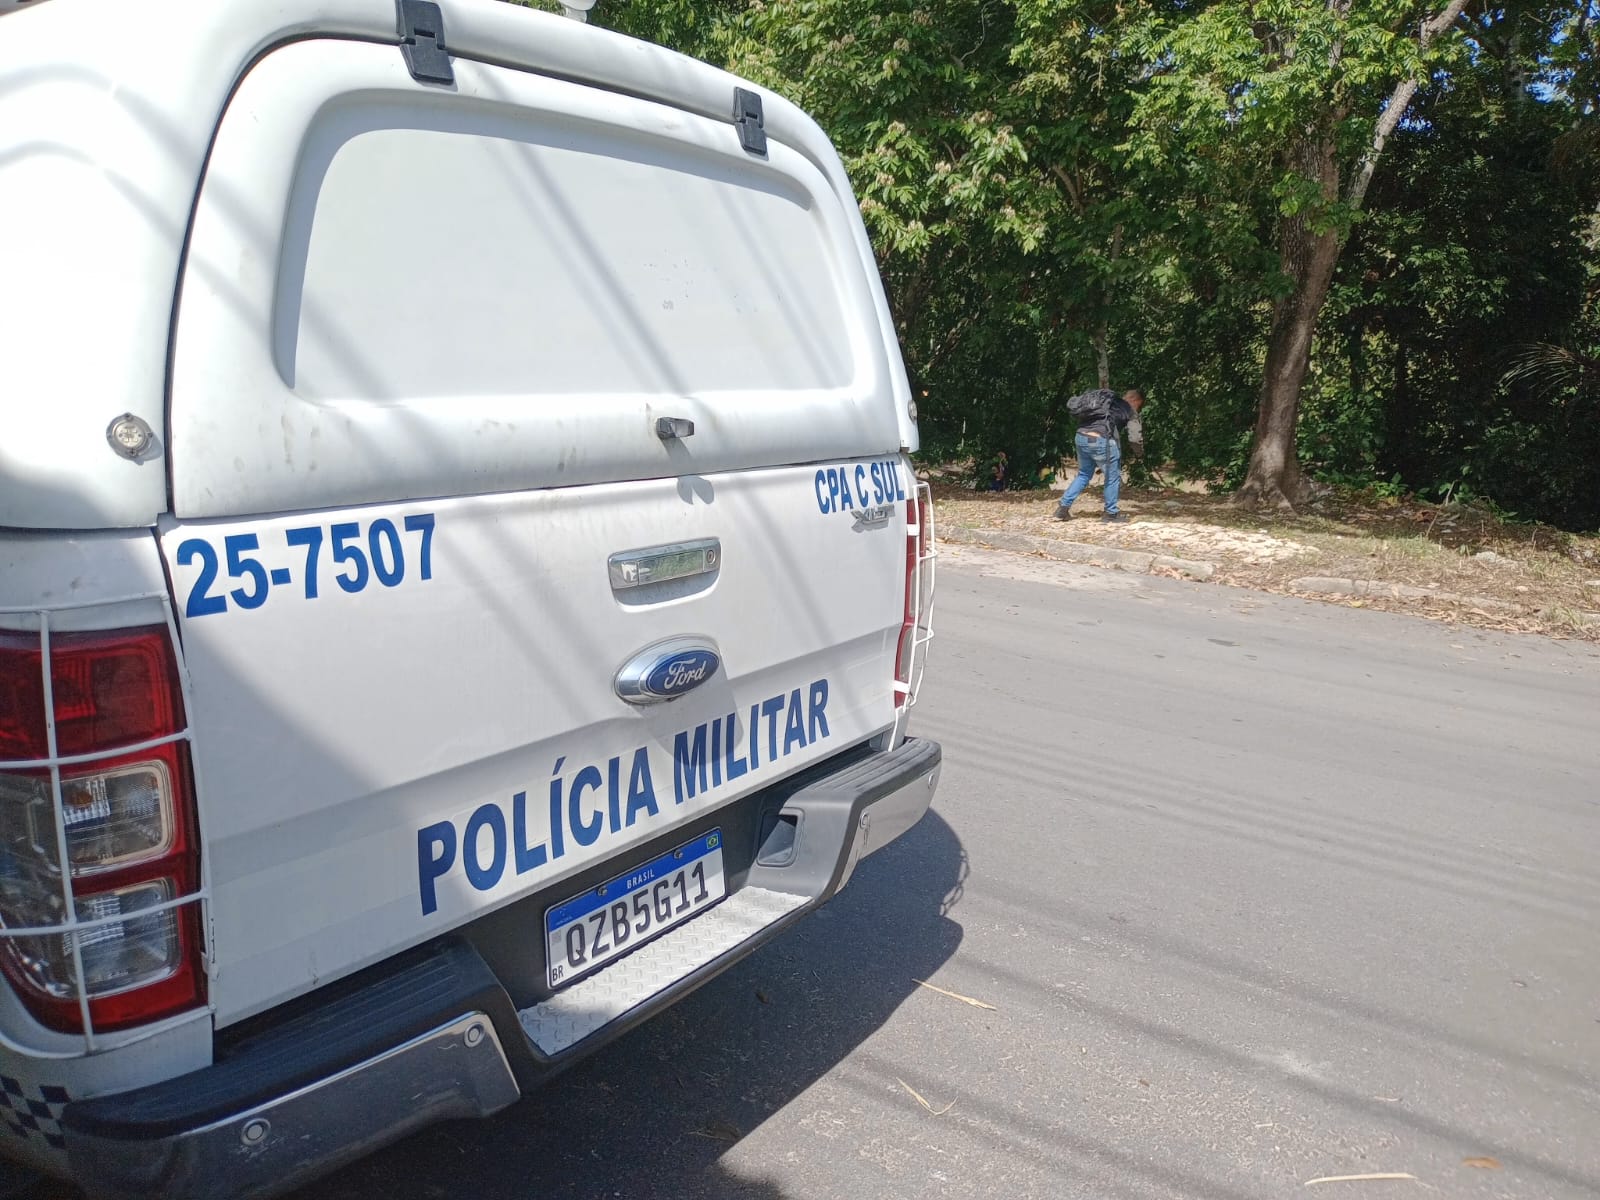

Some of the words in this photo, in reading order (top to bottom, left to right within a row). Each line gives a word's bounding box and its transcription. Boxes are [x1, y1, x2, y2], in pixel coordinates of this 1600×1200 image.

[815, 467, 854, 514] CPA
[855, 465, 868, 508] C
[871, 461, 904, 505] SUL
[176, 513, 435, 618] 25-7507
[664, 657, 707, 690] Ford
[417, 747, 659, 917] POLÍCIA
[673, 678, 830, 805] MILITAR
[626, 869, 655, 889] BRASIL
[566, 861, 709, 968] QZB5G11
[552, 965, 564, 982] BR
